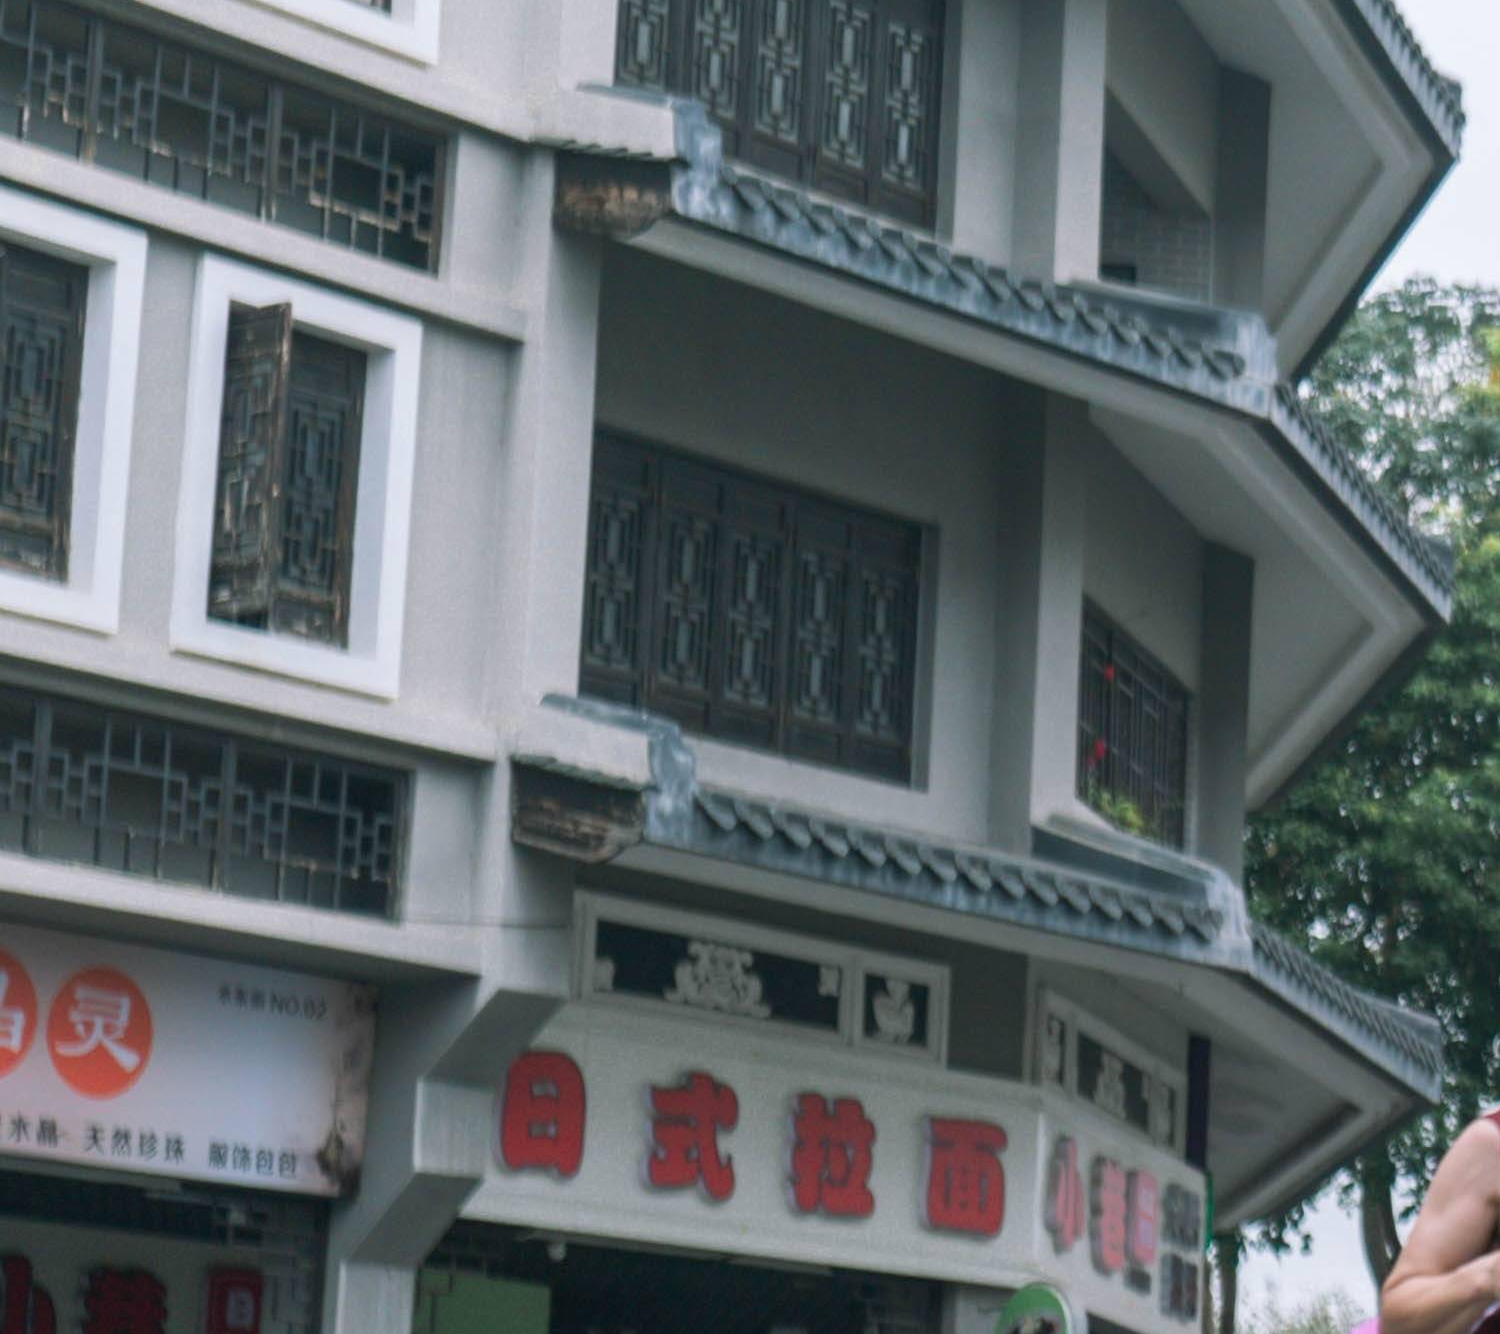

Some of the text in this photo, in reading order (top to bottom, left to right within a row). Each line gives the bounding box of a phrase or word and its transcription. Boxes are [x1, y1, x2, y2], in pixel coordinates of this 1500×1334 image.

[84, 1124, 186, 1164] 天然珍珠
[208, 1137, 297, 1179] 服饰包包
[499, 1050, 1009, 1237] 日式拉面
